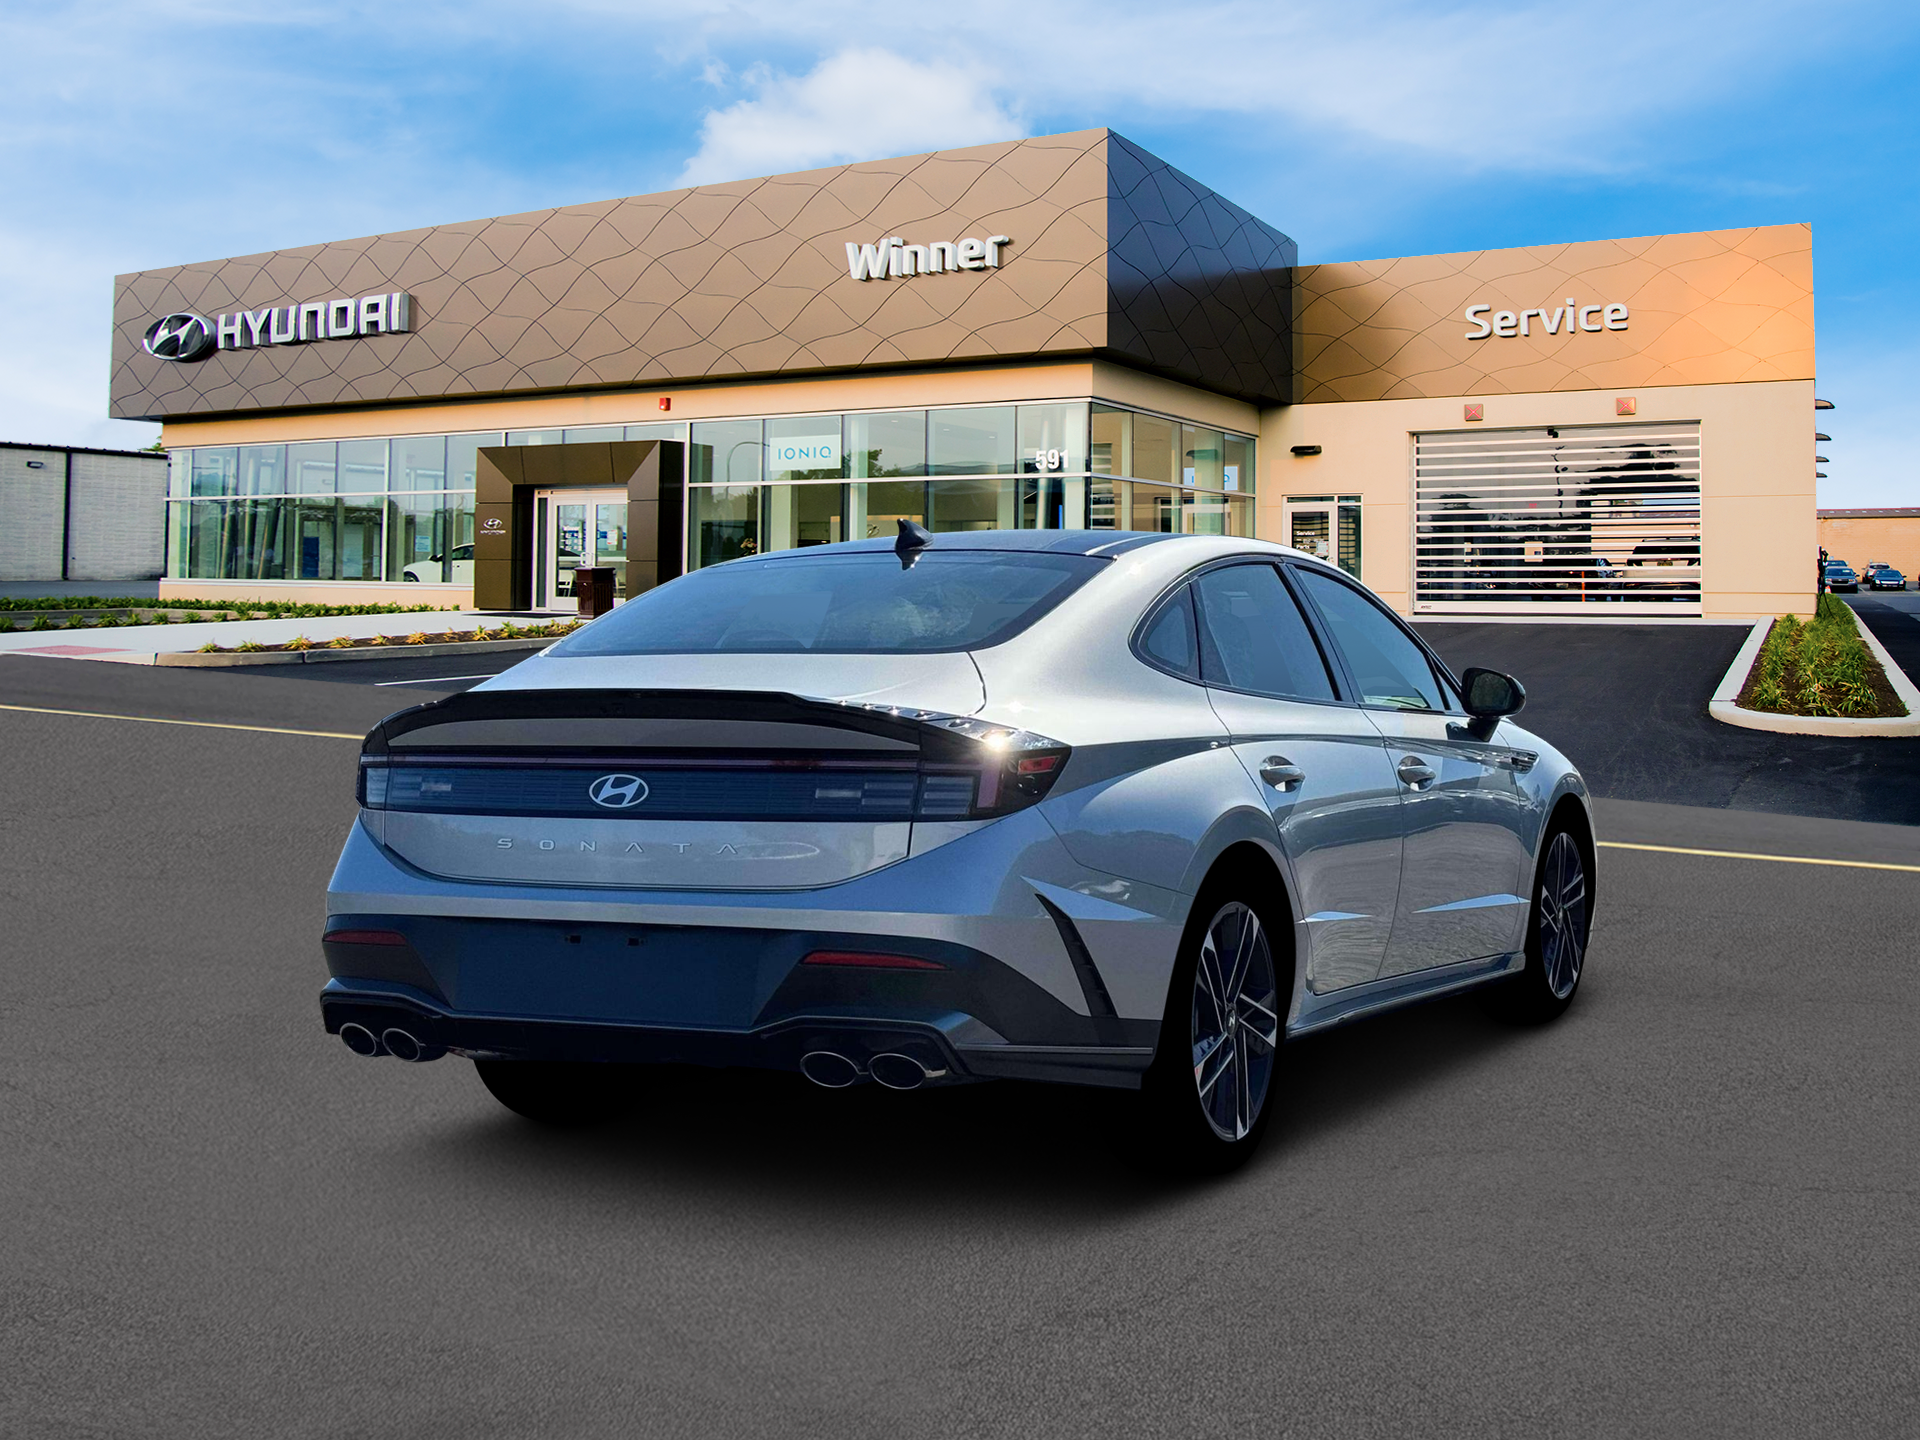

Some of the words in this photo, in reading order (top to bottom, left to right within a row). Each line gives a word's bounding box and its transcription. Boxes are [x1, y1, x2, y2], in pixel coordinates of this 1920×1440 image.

[845, 235, 1009, 281] Winner
[217, 292, 409, 349] HYUNDAI
[1464, 298, 1629, 340] Service
[777, 445, 832, 460] IONIQ
[1035, 449, 1069, 469] 591
[497, 838, 737, 854] SONATA
